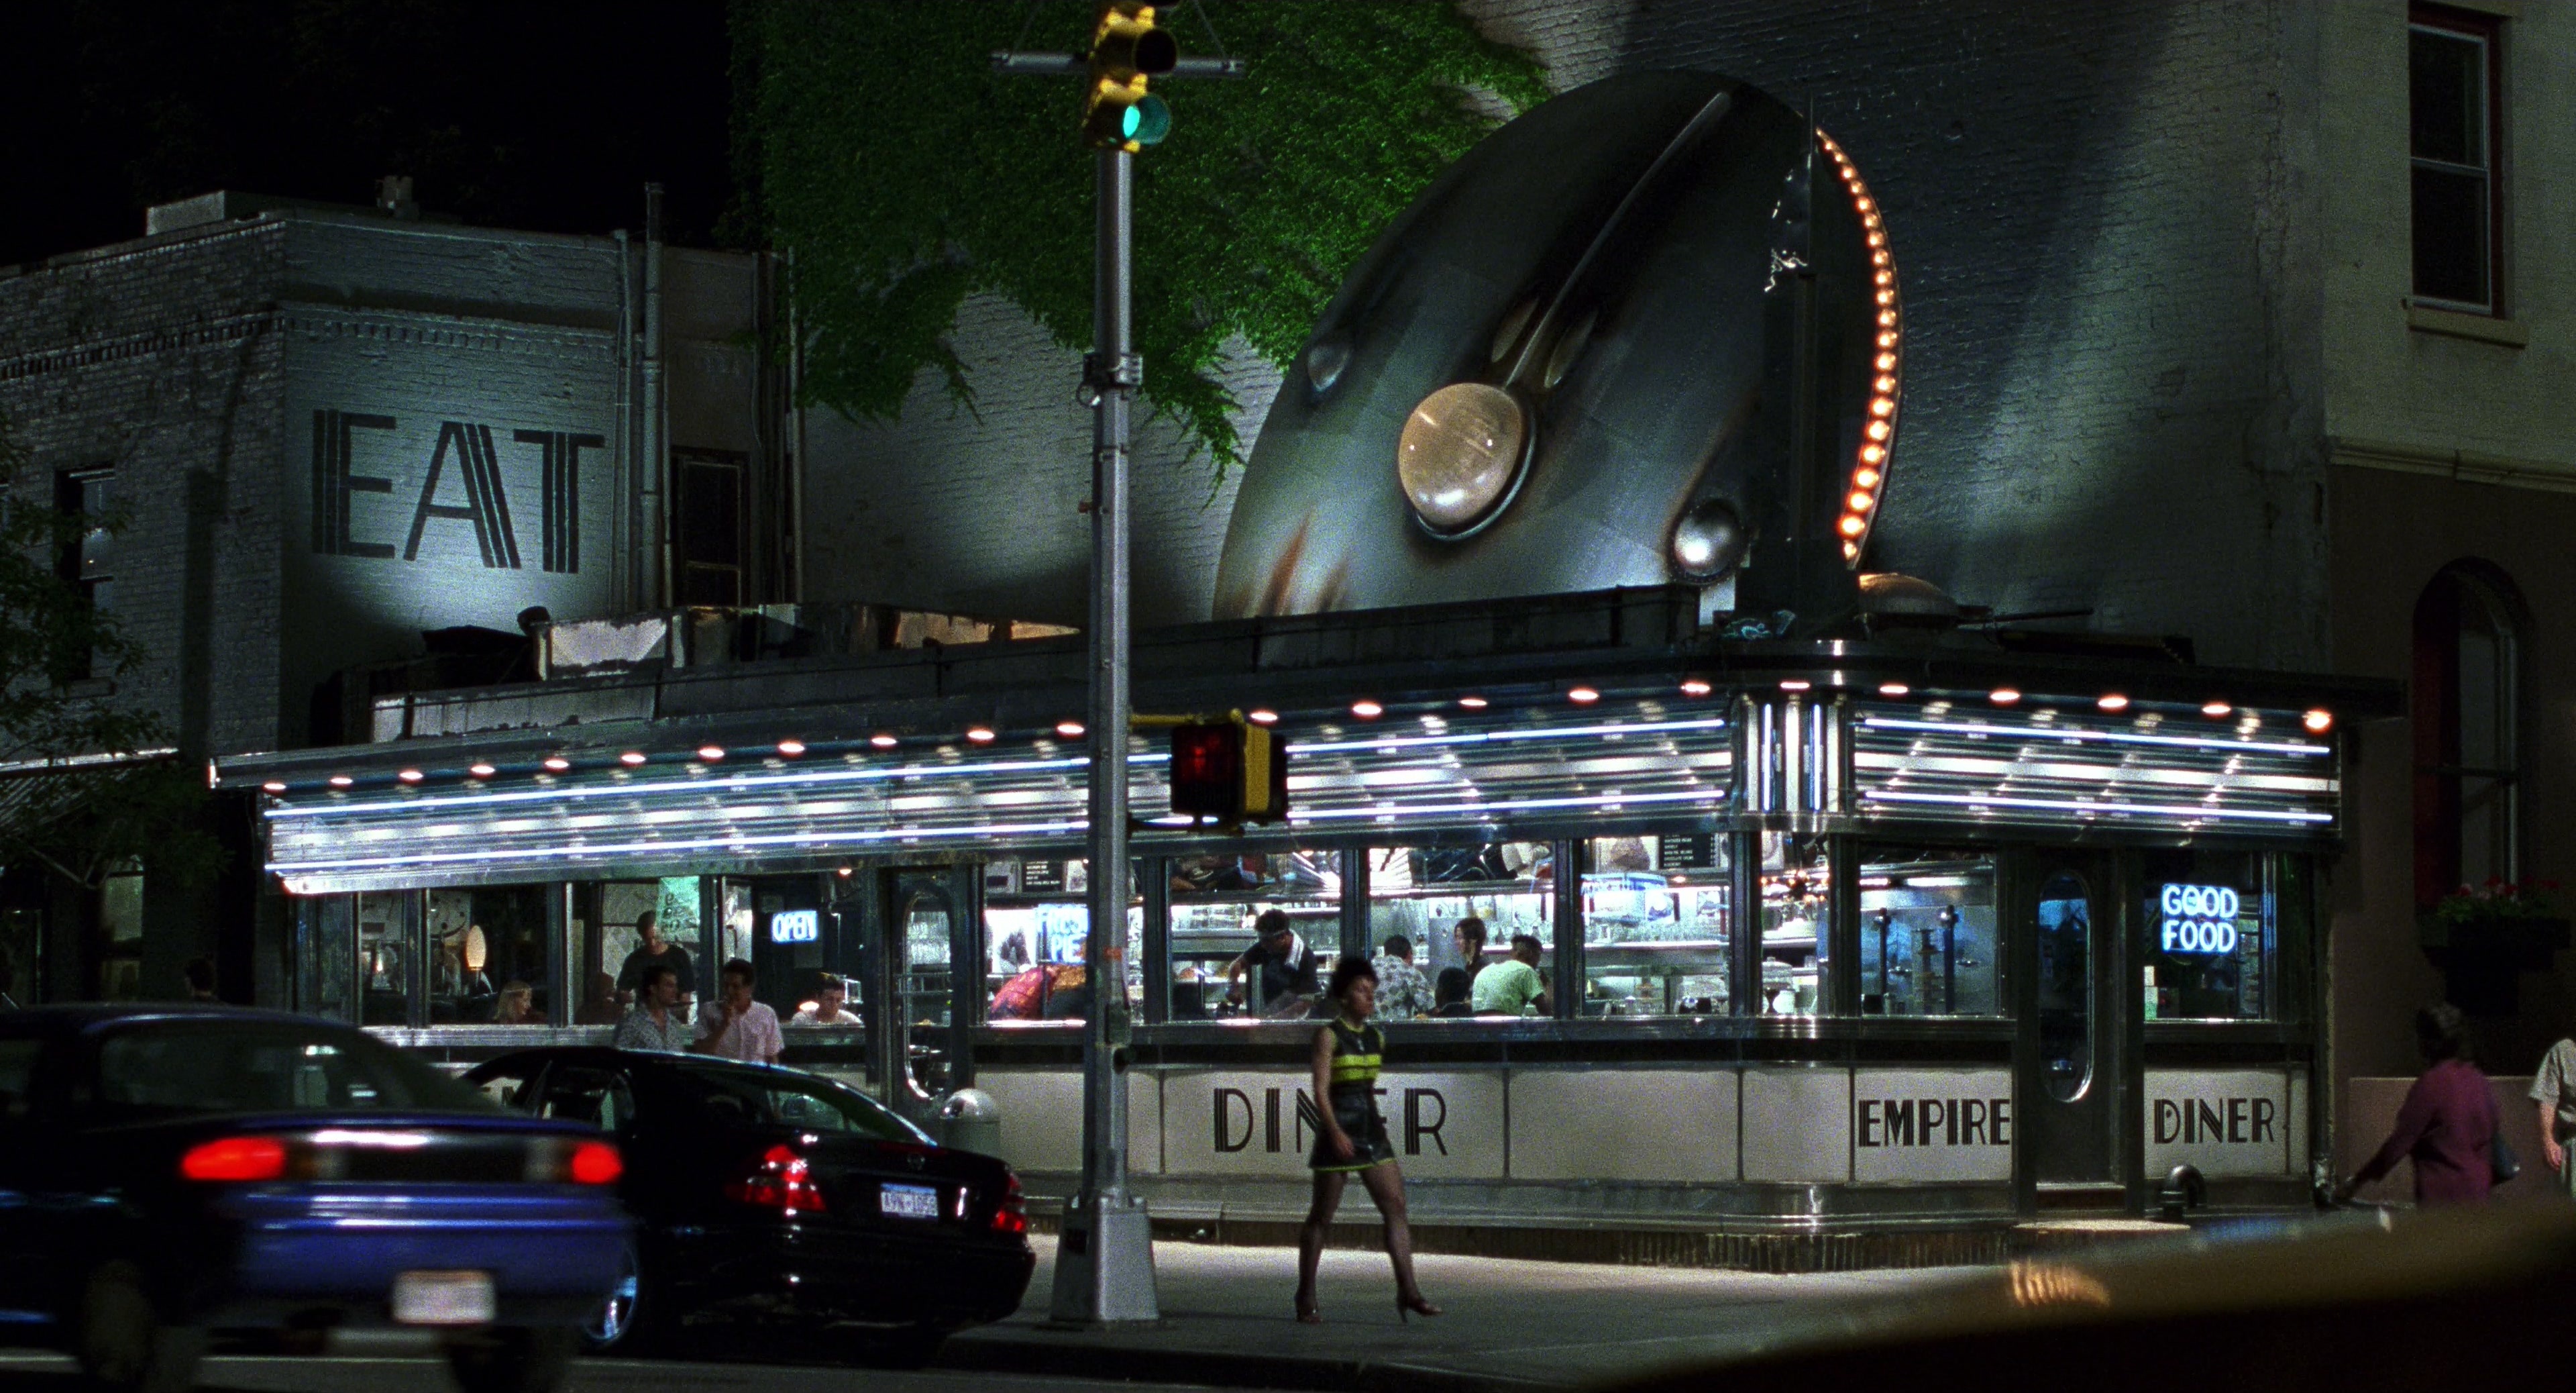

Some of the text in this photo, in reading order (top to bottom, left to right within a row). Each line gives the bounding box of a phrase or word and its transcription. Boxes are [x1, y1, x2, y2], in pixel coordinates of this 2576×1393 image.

[312, 409, 603, 574] EAT
[2162, 885, 2239, 919] GOOD
[772, 911, 817, 942] OPEN
[2163, 919, 2235, 952] FOOD
[1214, 1088, 1448, 1155] DINR
[1858, 1098, 2275, 1147] EMPIRE DINER
